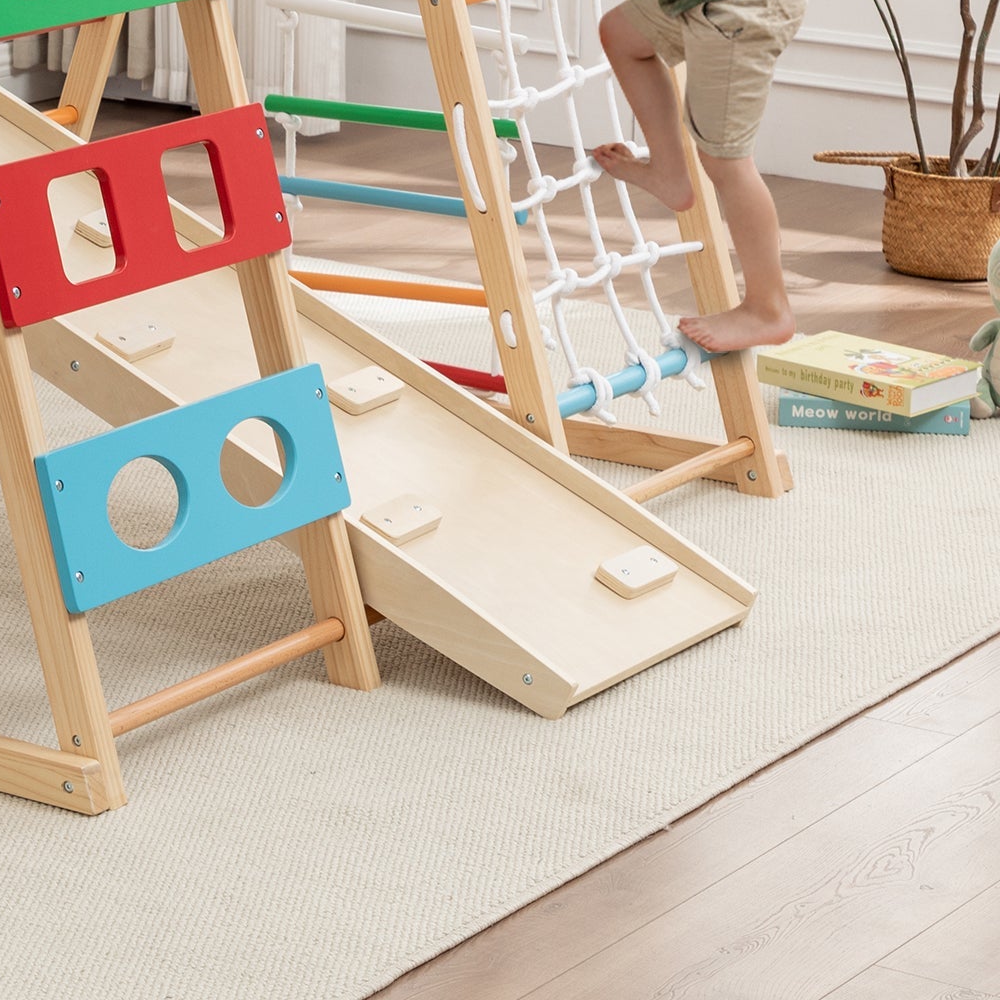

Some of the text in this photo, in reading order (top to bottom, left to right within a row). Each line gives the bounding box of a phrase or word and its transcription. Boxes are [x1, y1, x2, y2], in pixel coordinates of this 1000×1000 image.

[800, 368, 832, 389] birthday
[834, 378, 855, 394] party
[791, 404, 892, 422] Meow world
